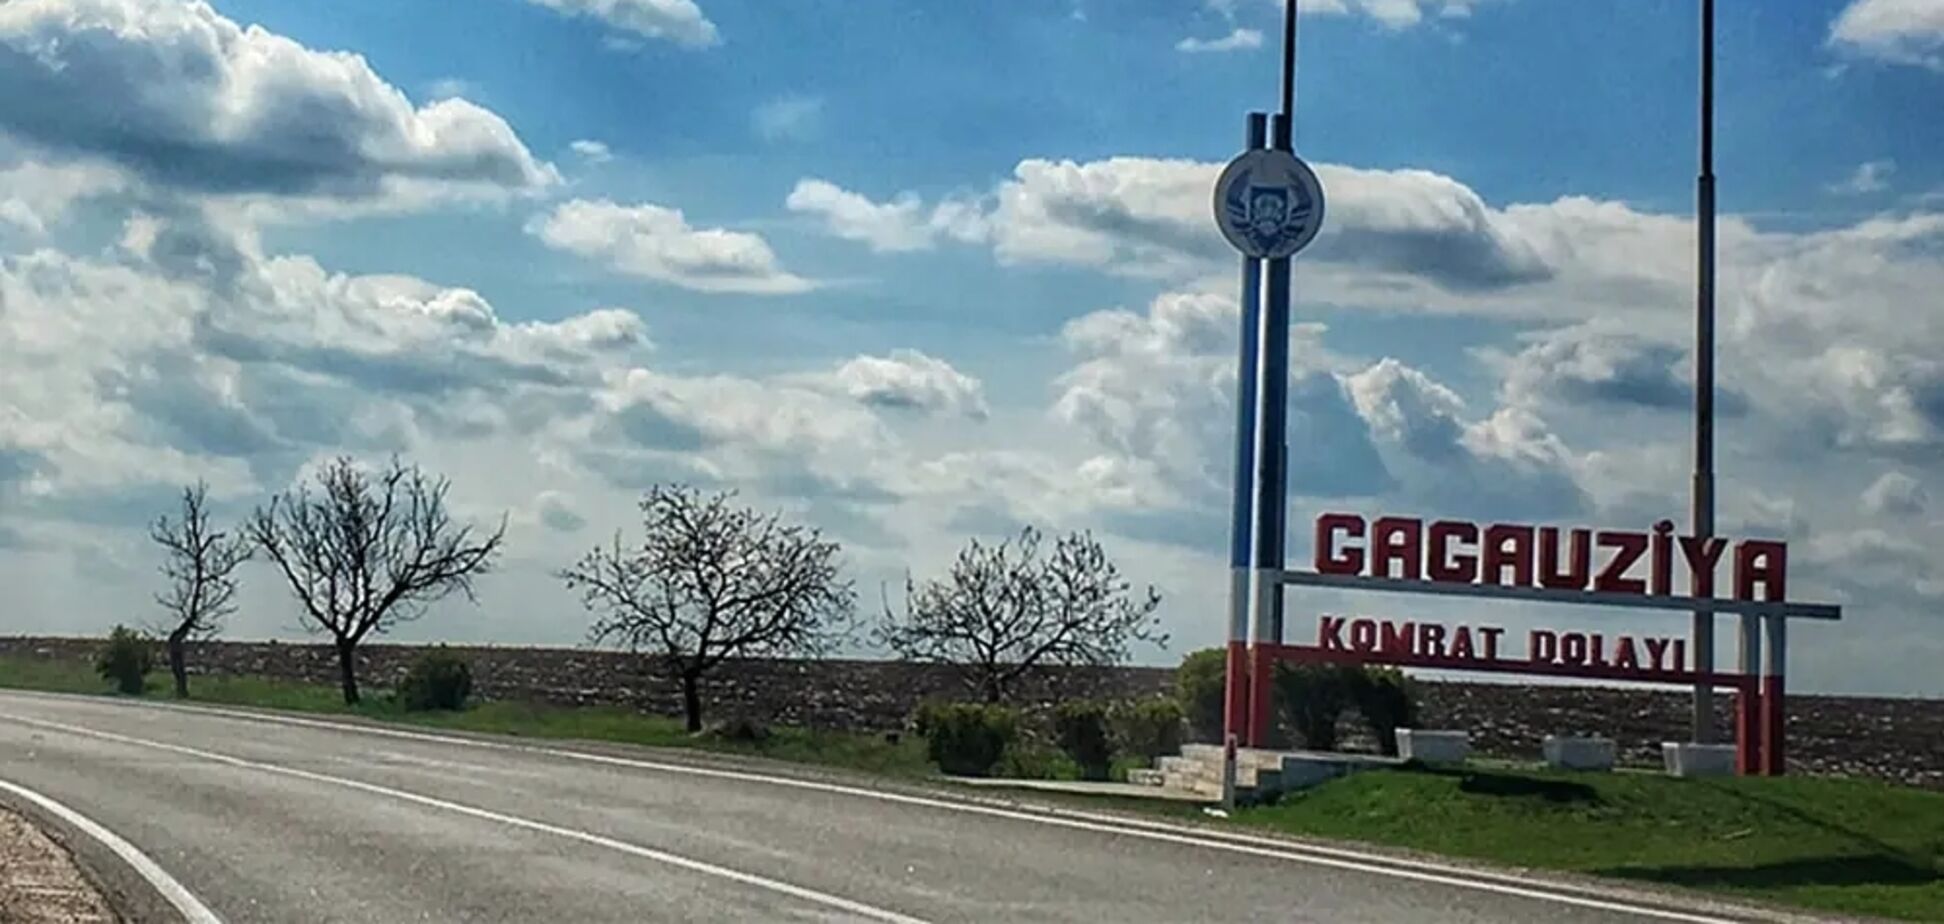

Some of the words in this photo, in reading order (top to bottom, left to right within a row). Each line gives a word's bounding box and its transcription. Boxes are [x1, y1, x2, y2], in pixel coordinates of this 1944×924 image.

[1315, 513, 1787, 600] GAGAUZİYA
[1319, 616, 1504, 660] KOMRAT
[1530, 630, 1687, 671] DOLAYI
